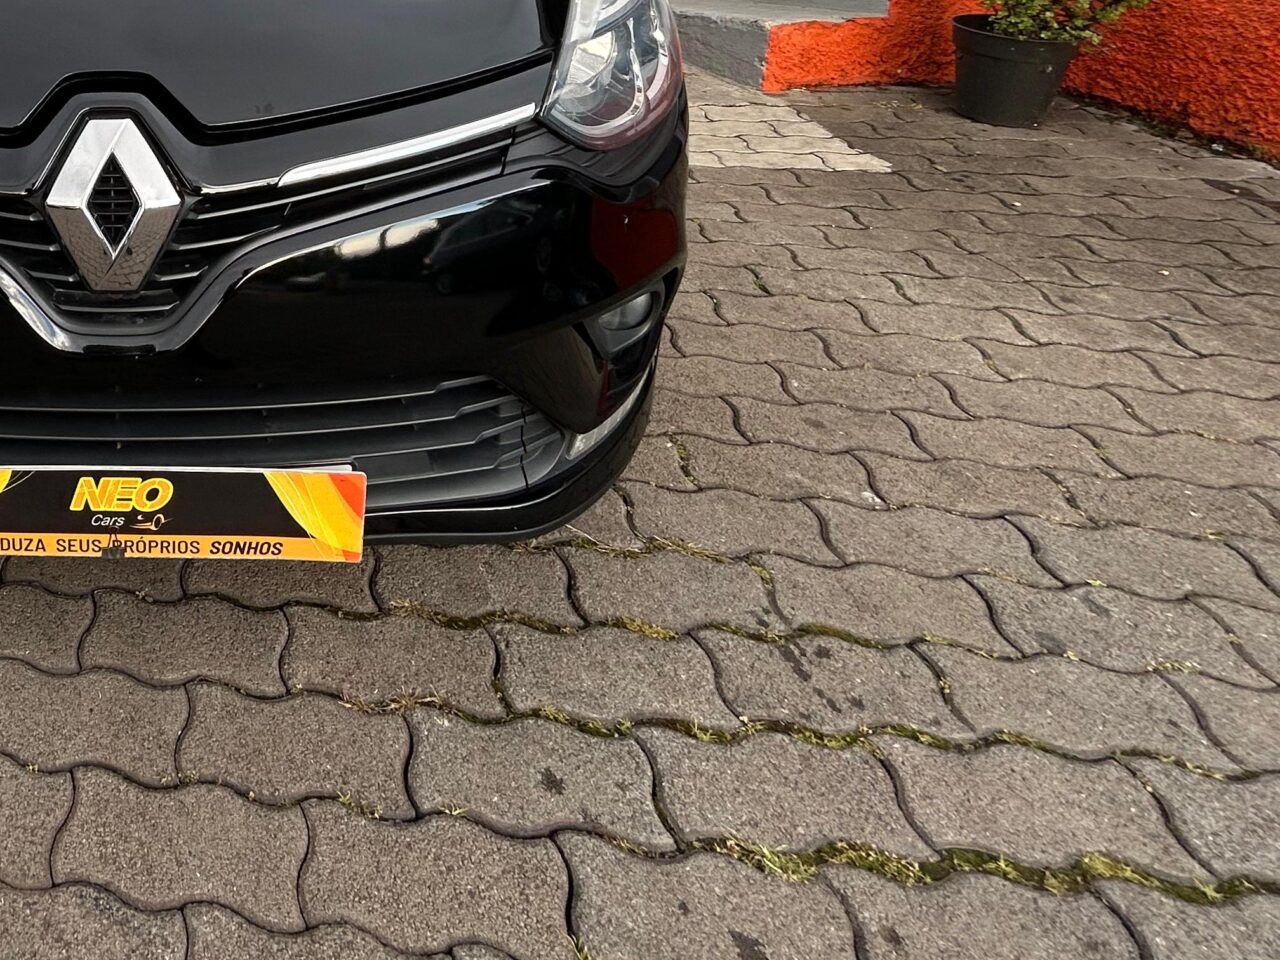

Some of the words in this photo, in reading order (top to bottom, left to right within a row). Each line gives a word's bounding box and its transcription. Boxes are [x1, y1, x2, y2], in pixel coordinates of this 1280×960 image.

[70, 477, 174, 512] NEO
[91, 514, 125, 526] Cars
[56, 539, 102, 553] SEUS
[209, 541, 283, 556] SONHOS
